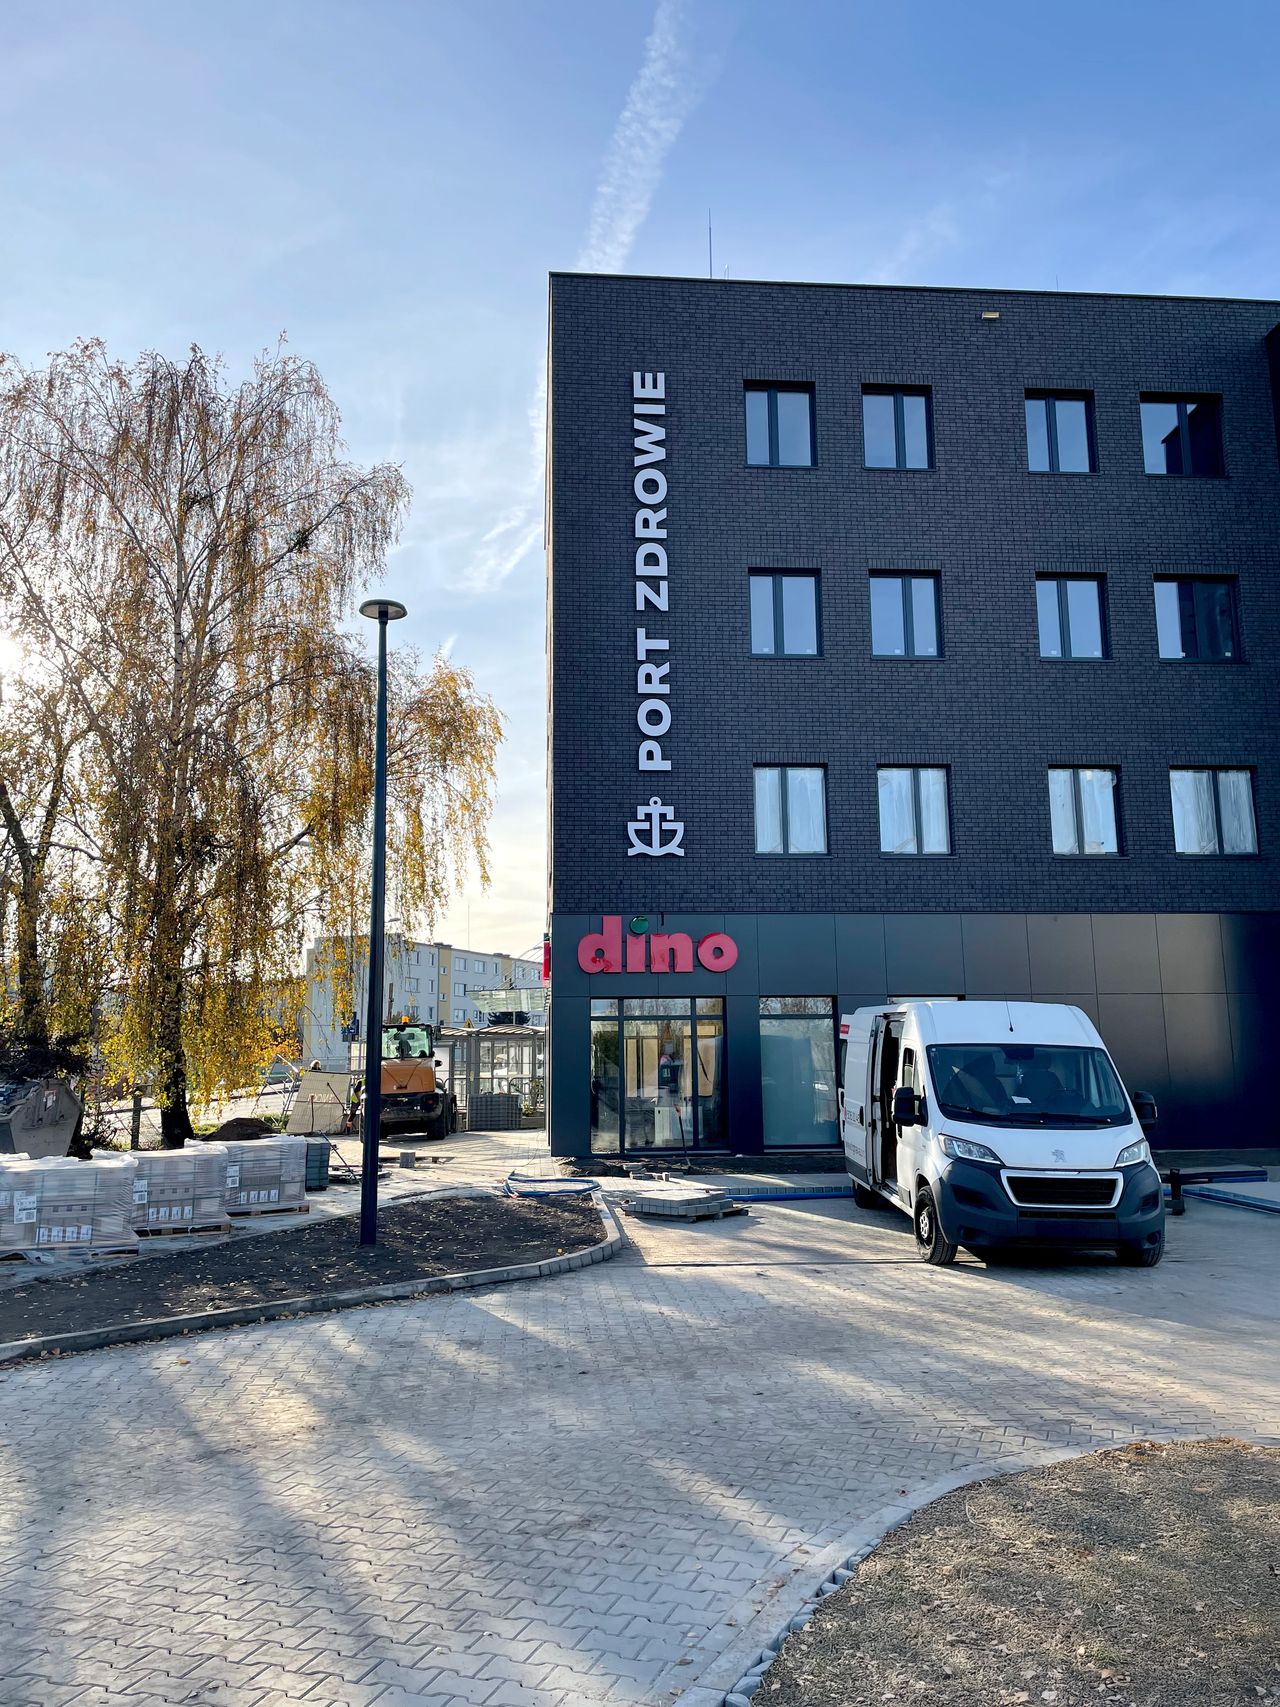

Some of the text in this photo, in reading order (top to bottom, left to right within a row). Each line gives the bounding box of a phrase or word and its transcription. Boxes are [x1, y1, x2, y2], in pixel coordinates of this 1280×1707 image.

[633, 371, 672, 771] PORT ZDROWIE
[577, 915, 738, 974] dino
